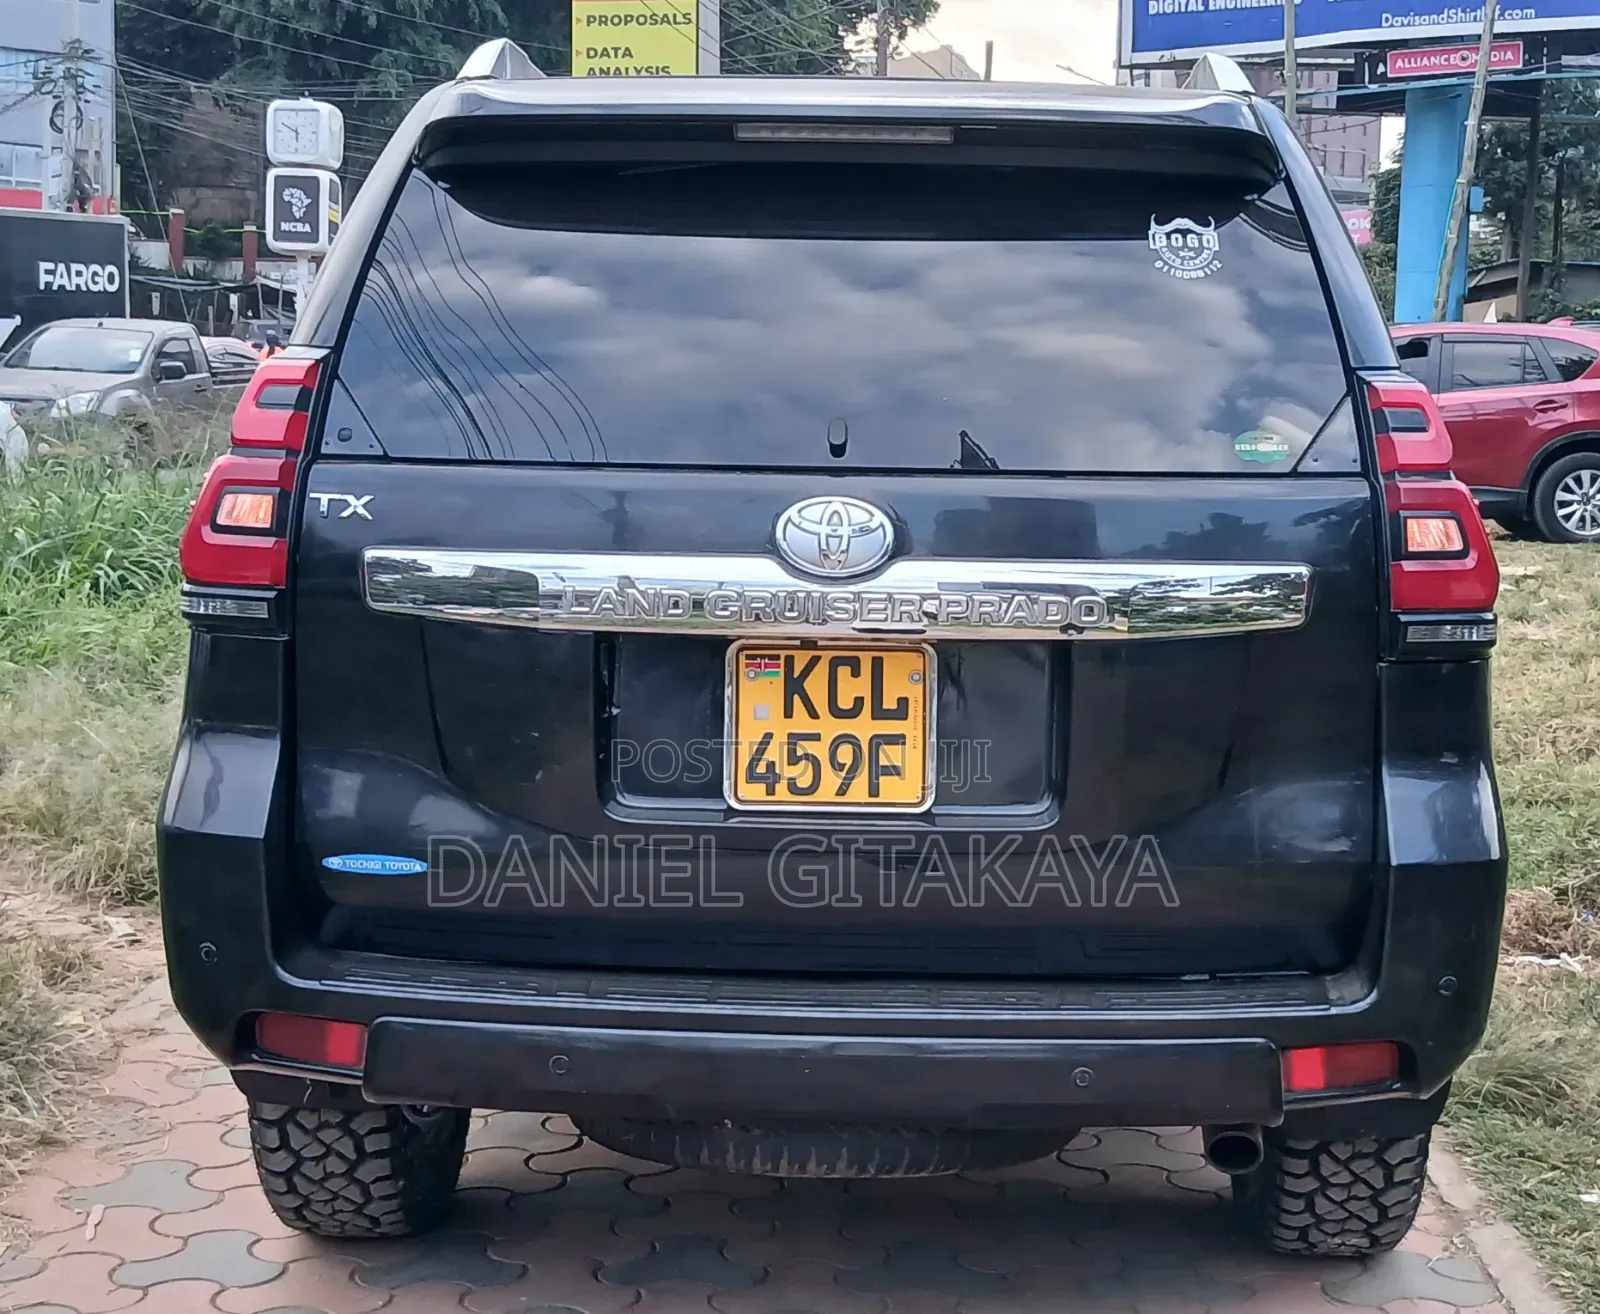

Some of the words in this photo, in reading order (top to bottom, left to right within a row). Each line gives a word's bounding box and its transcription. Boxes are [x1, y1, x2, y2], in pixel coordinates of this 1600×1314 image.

[1148, 0, 1205, 15] DIGITAL
[1381, 5, 1536, 28] DavisandShirtlf.com
[586, 13, 693, 27] PROPOSALS
[586, 47, 634, 60] DATA
[1395, 53, 1457, 69] ALLIANCE
[1471, 50, 1514, 64] MDIA
[587, 66, 671, 76] ANALYSIS
[280, 222, 312, 233] NCBA
[1154, 233, 1214, 248] BOGO
[1161, 247, 1182, 265] AUTO
[38, 261, 120, 293] FARGO
[309, 492, 374, 520] TX
[563, 585, 693, 620] LAND
[935, 594, 1109, 627] PRADO
[783, 654, 909, 721] KCL
[745, 732, 907, 798] 459F
[385, 861, 421, 872] TOYOTA
